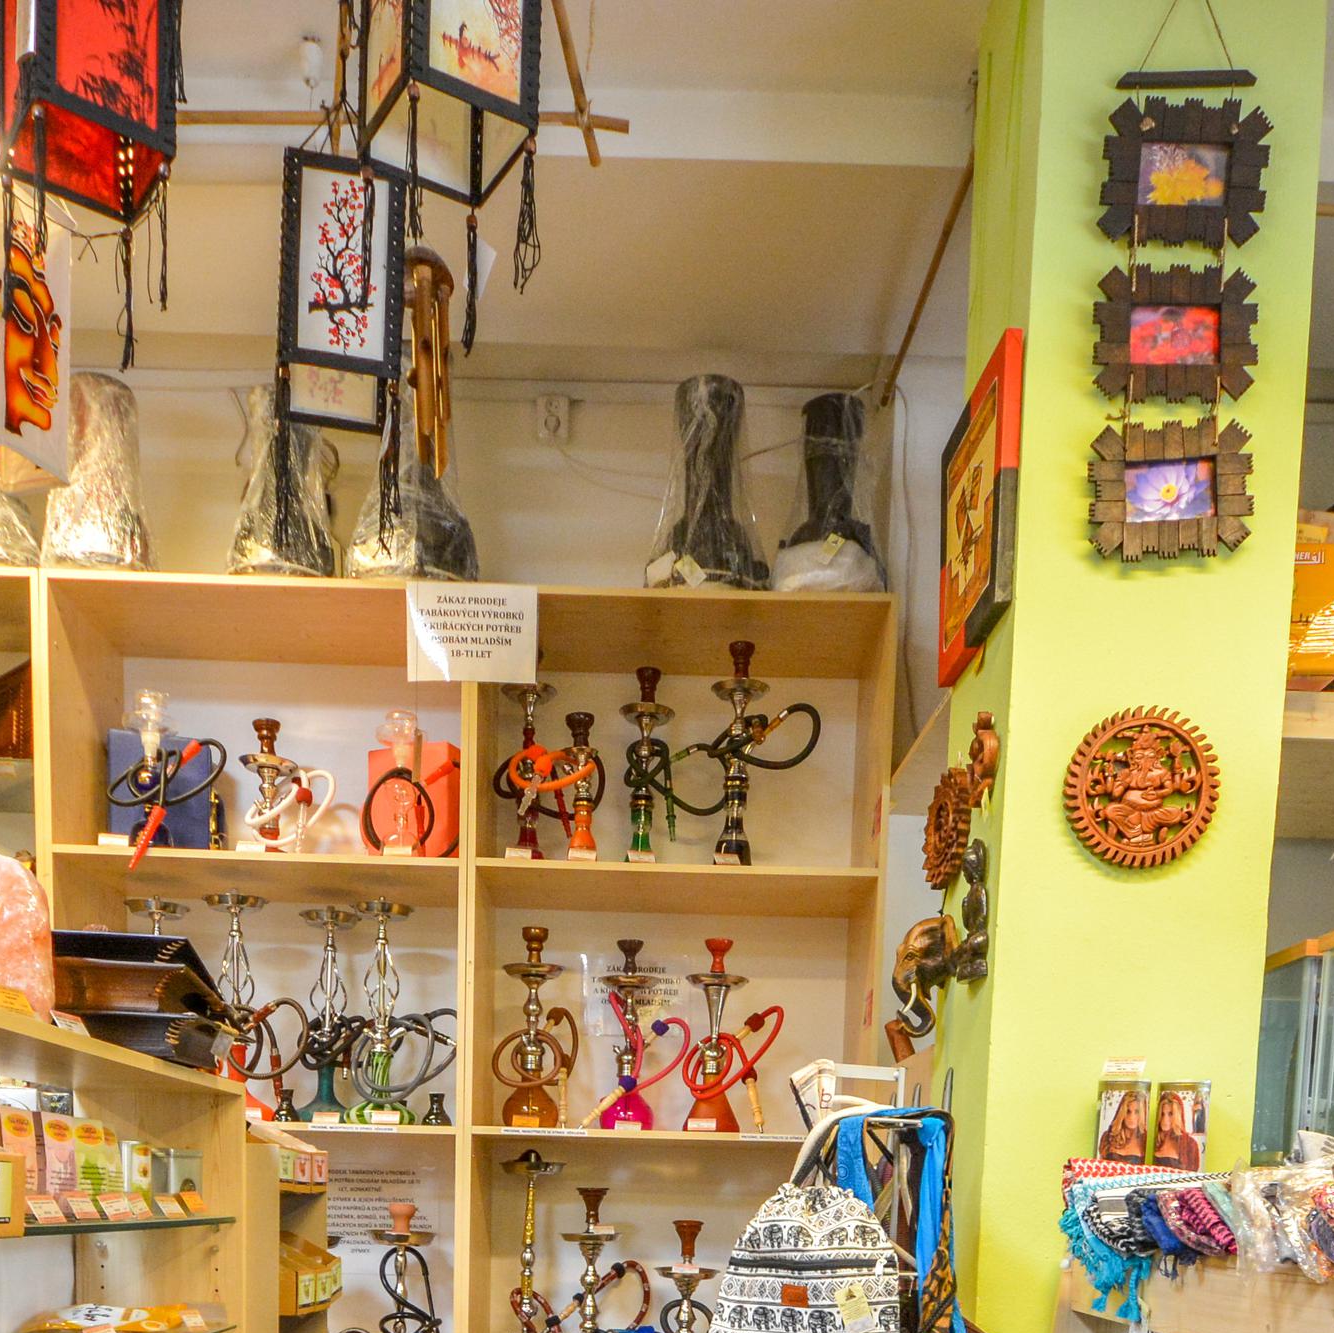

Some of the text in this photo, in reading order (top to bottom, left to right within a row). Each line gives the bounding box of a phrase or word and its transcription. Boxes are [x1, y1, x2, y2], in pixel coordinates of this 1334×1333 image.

[437, 595, 507, 607] ZÁKAZ PRODEJE
[419, 608, 524, 621] TABÁKOVÝCH VÝROBKŮ
[430, 621, 522, 634] KUŘÁCKÝCH POTŘEB
[470, 634, 512, 646] MLADŠÍM
[451, 649, 492, 659] 18-TI LET
